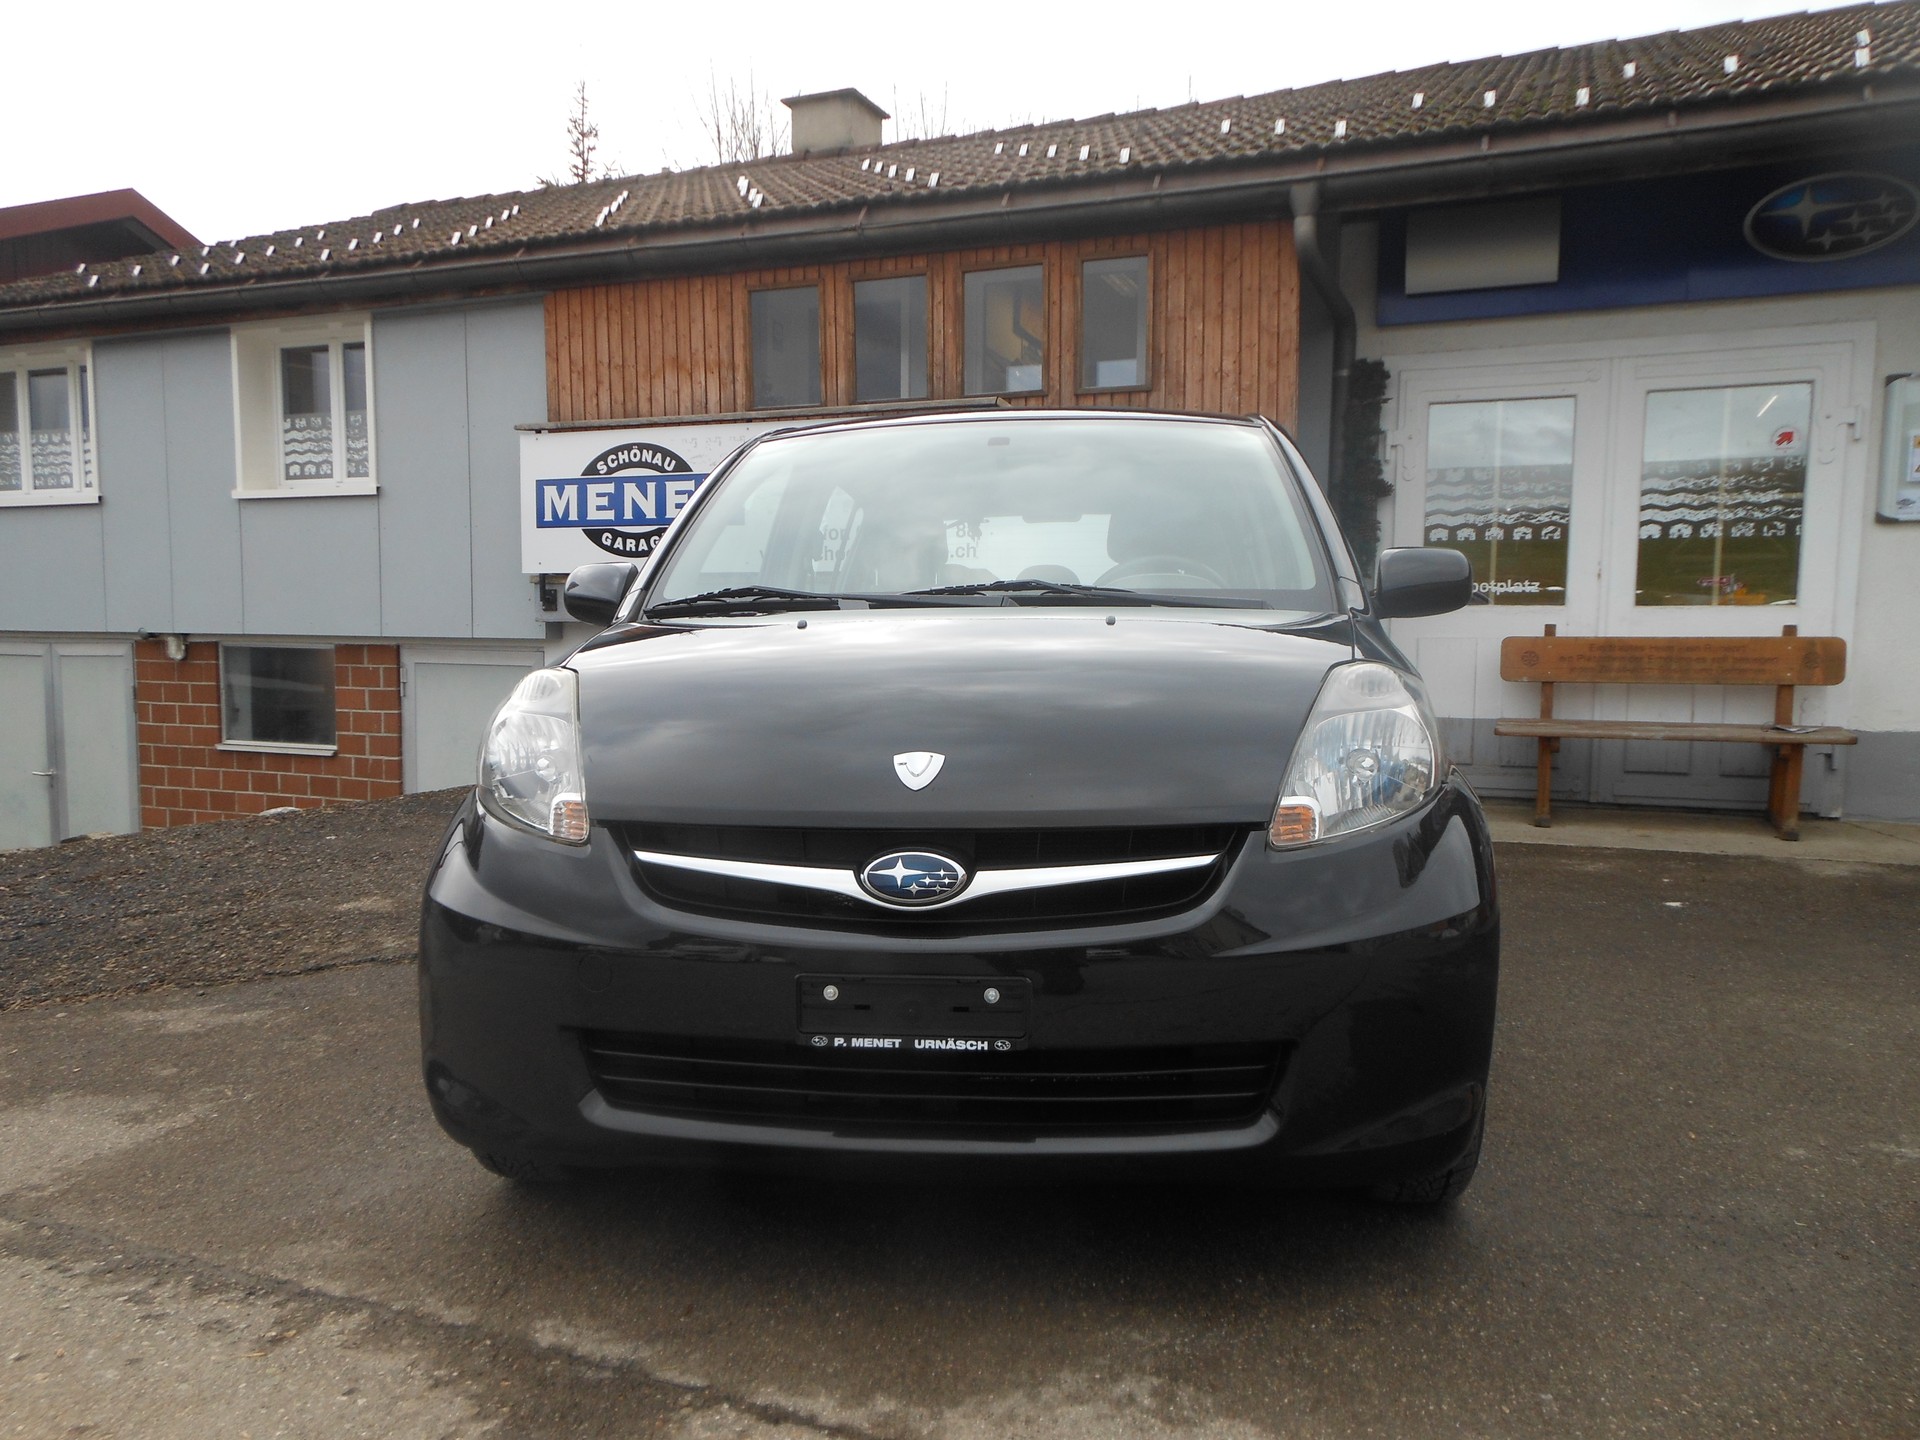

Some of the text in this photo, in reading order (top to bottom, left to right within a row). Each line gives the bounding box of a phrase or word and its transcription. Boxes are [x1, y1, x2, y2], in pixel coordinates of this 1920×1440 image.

[596, 445, 677, 475] SCHÖNAU
[543, 480, 696, 521] MENE
[601, 532, 666, 552] GARAG
[834, 1037, 988, 1050] P. MENET URNÄSCH
